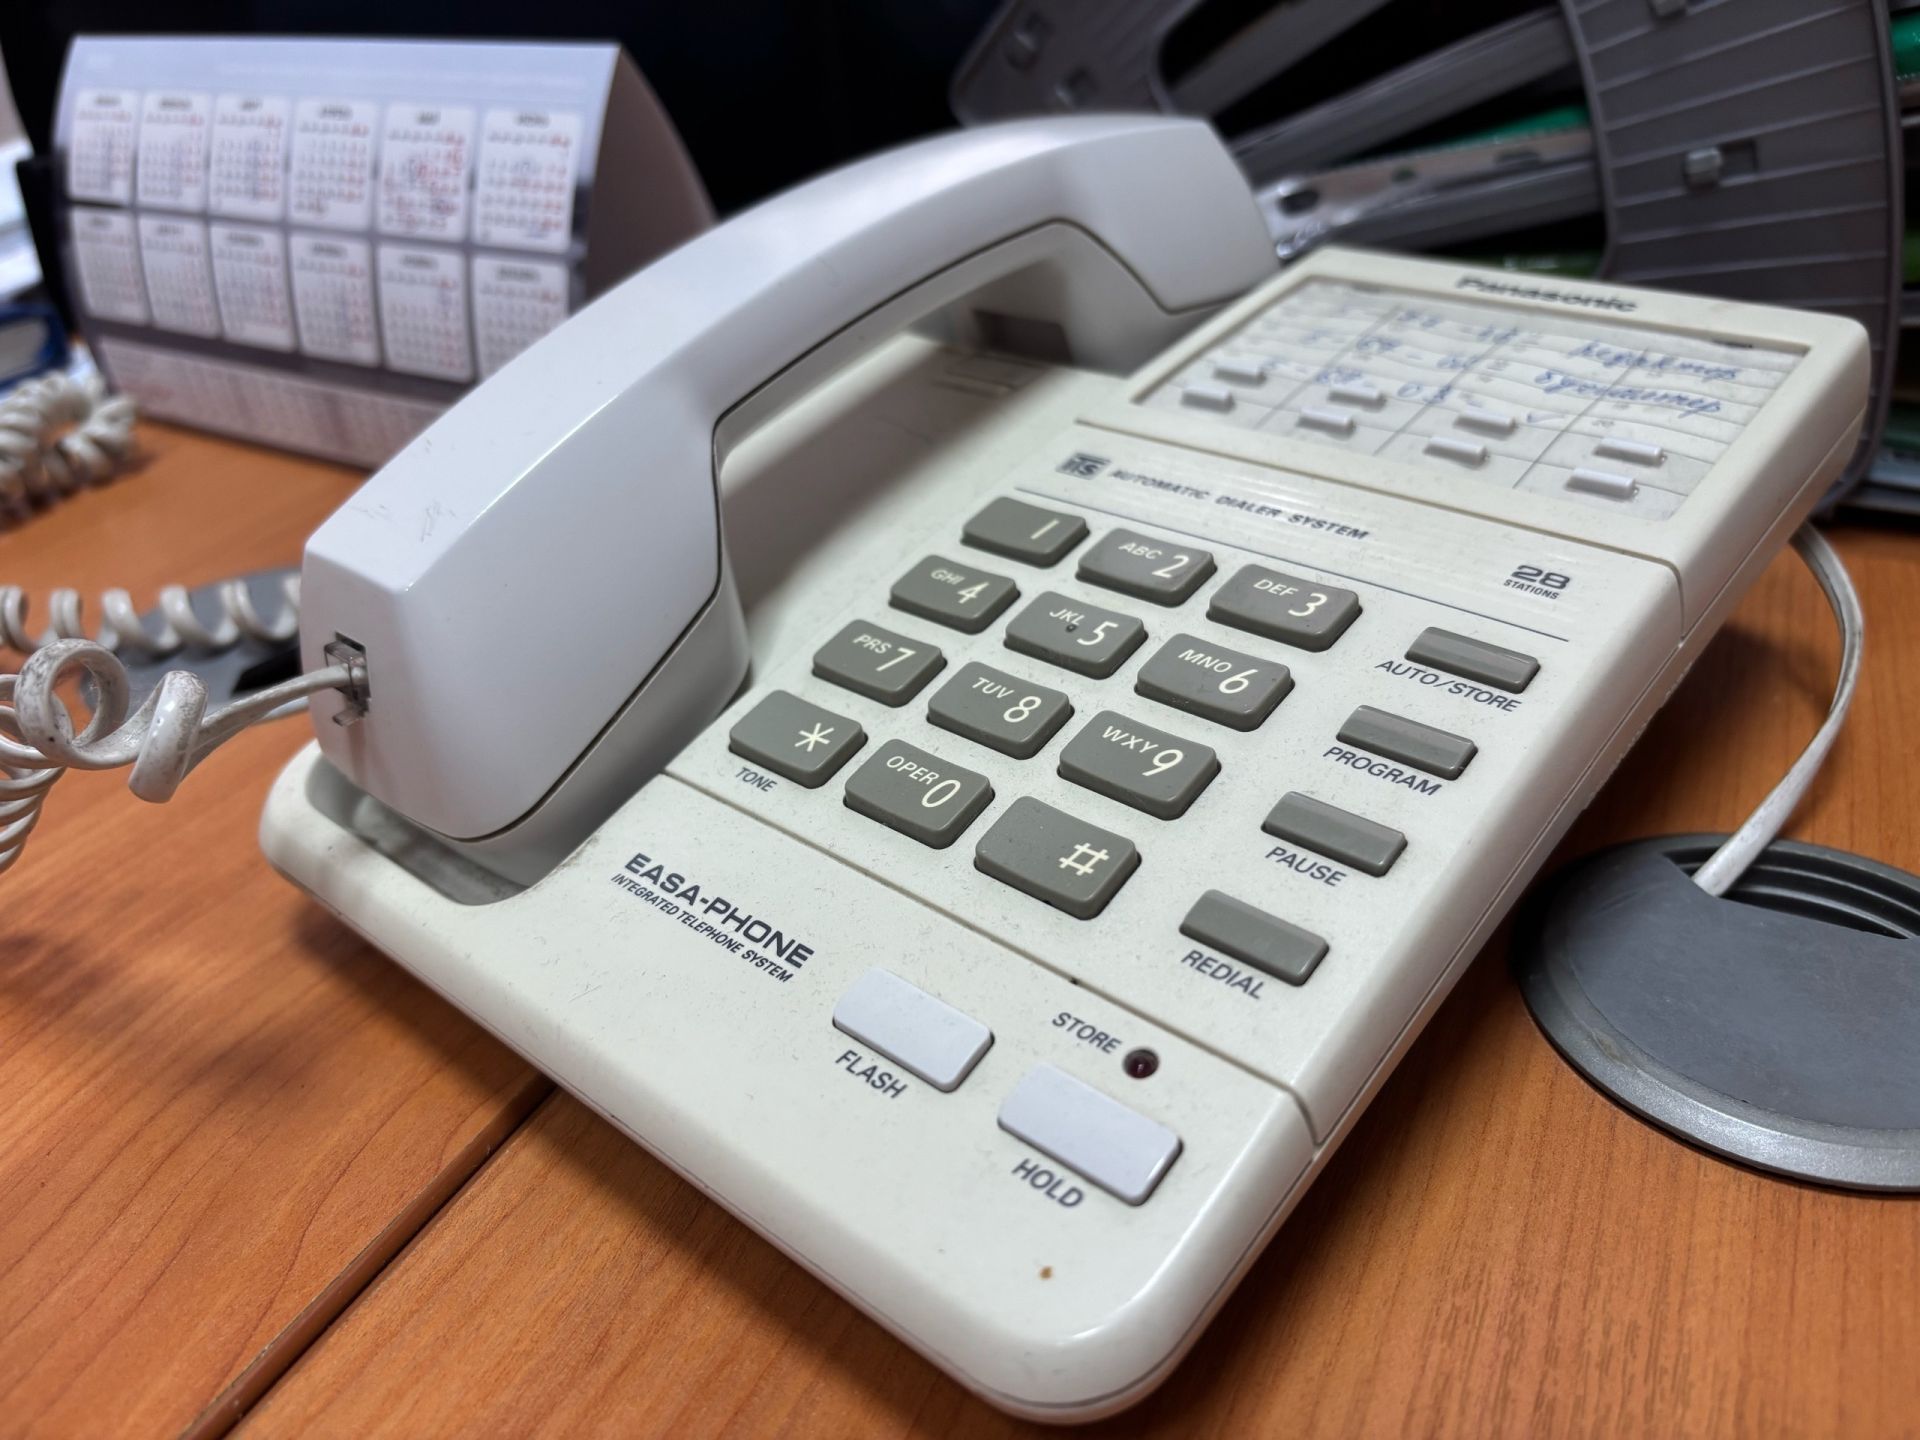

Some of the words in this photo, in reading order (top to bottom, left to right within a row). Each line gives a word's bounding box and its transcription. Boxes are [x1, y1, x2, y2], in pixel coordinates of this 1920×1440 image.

[1109, 469, 1210, 501] AUTOMATIC
[1213, 495, 1282, 518] DIALER
[1287, 513, 1370, 541] SYSTEM
[1118, 540, 1163, 561] ABC
[1153, 554, 1189, 579] 2
[1511, 565, 1570, 590] 28
[930, 567, 962, 587] GHI
[957, 581, 990, 604] 4
[1253, 578, 1299, 598] DEF
[1288, 592, 1328, 617] 3
[1503, 579, 1560, 601] STATIONS
[1049, 607, 1084, 627] JKL
[1077, 621, 1118, 647] 5
[852, 633, 893, 655] PRS
[876, 649, 915, 673] 7
[1178, 648, 1231, 674] MNO
[1218, 668, 1259, 694] 6
[971, 677, 1015, 698] TUV
[1002, 695, 1043, 723] 8
[1374, 658, 1523, 714] AUTO/STORE
[886, 755, 941, 785] OPER
[1101, 725, 1159, 754] WXY
[1141, 748, 1185, 777] 9
[1323, 746, 1442, 797] PROGRAM
[733, 766, 778, 793] TONE
[1265, 846, 1347, 888] PAUSE
[611, 873, 680, 916] INTEGRATED
[676, 910, 745, 954] TELEPHONE
[741, 949, 794, 983] SYSTEM
[624, 852, 815, 969] EASA-PHONE
[1181, 949, 1266, 1000] REDIAL
[1052, 1011, 1122, 1055] STORE
[835, 1048, 908, 1100] FLASH
[1011, 1158, 1086, 1210] HOLD
